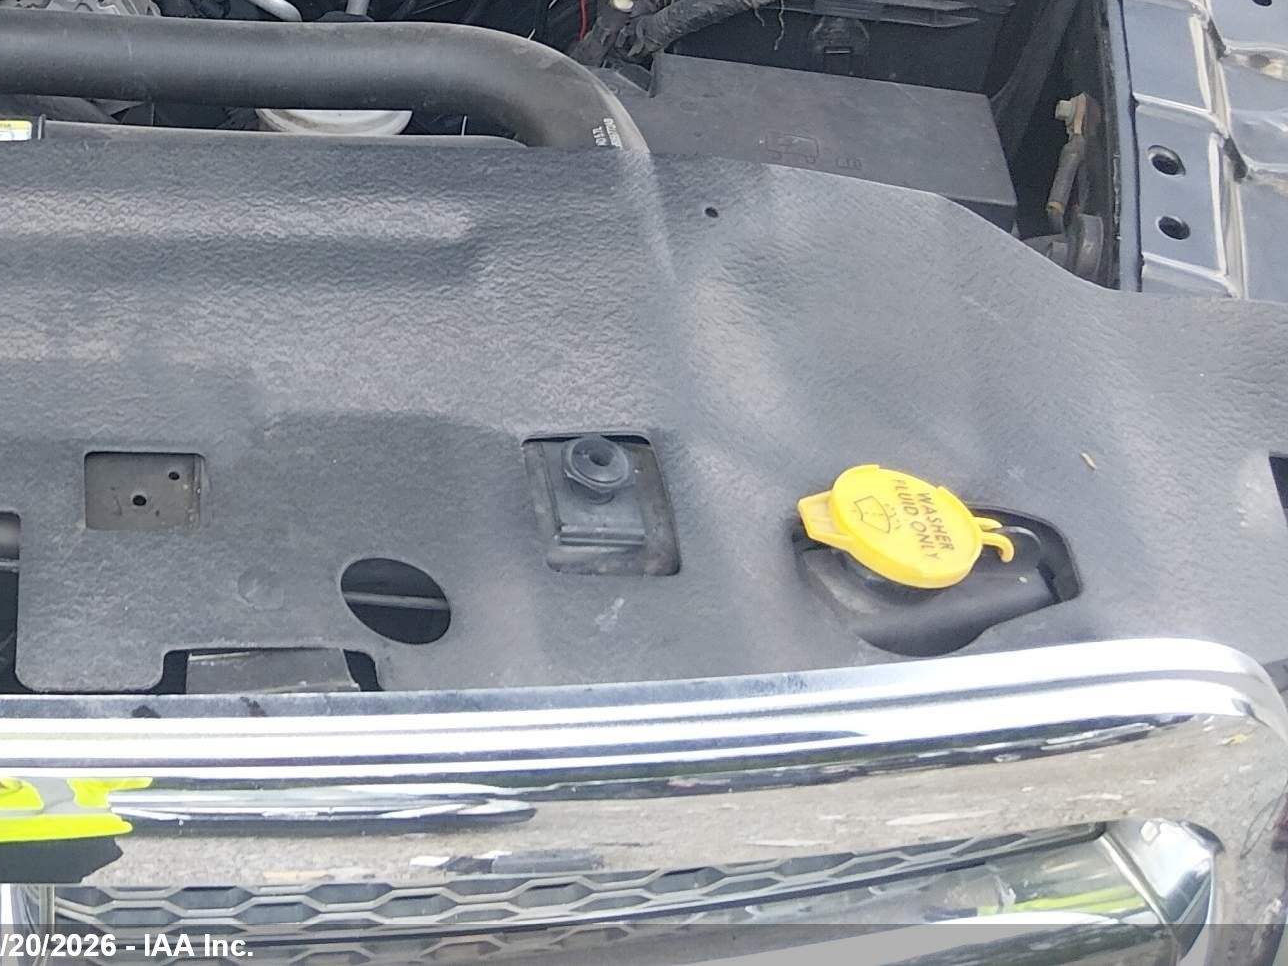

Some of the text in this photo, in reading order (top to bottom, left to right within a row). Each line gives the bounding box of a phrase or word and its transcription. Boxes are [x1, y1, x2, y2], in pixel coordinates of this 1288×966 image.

[892, 479, 941, 559] FLUID ONLY
[917, 492, 955, 550] WASHER
